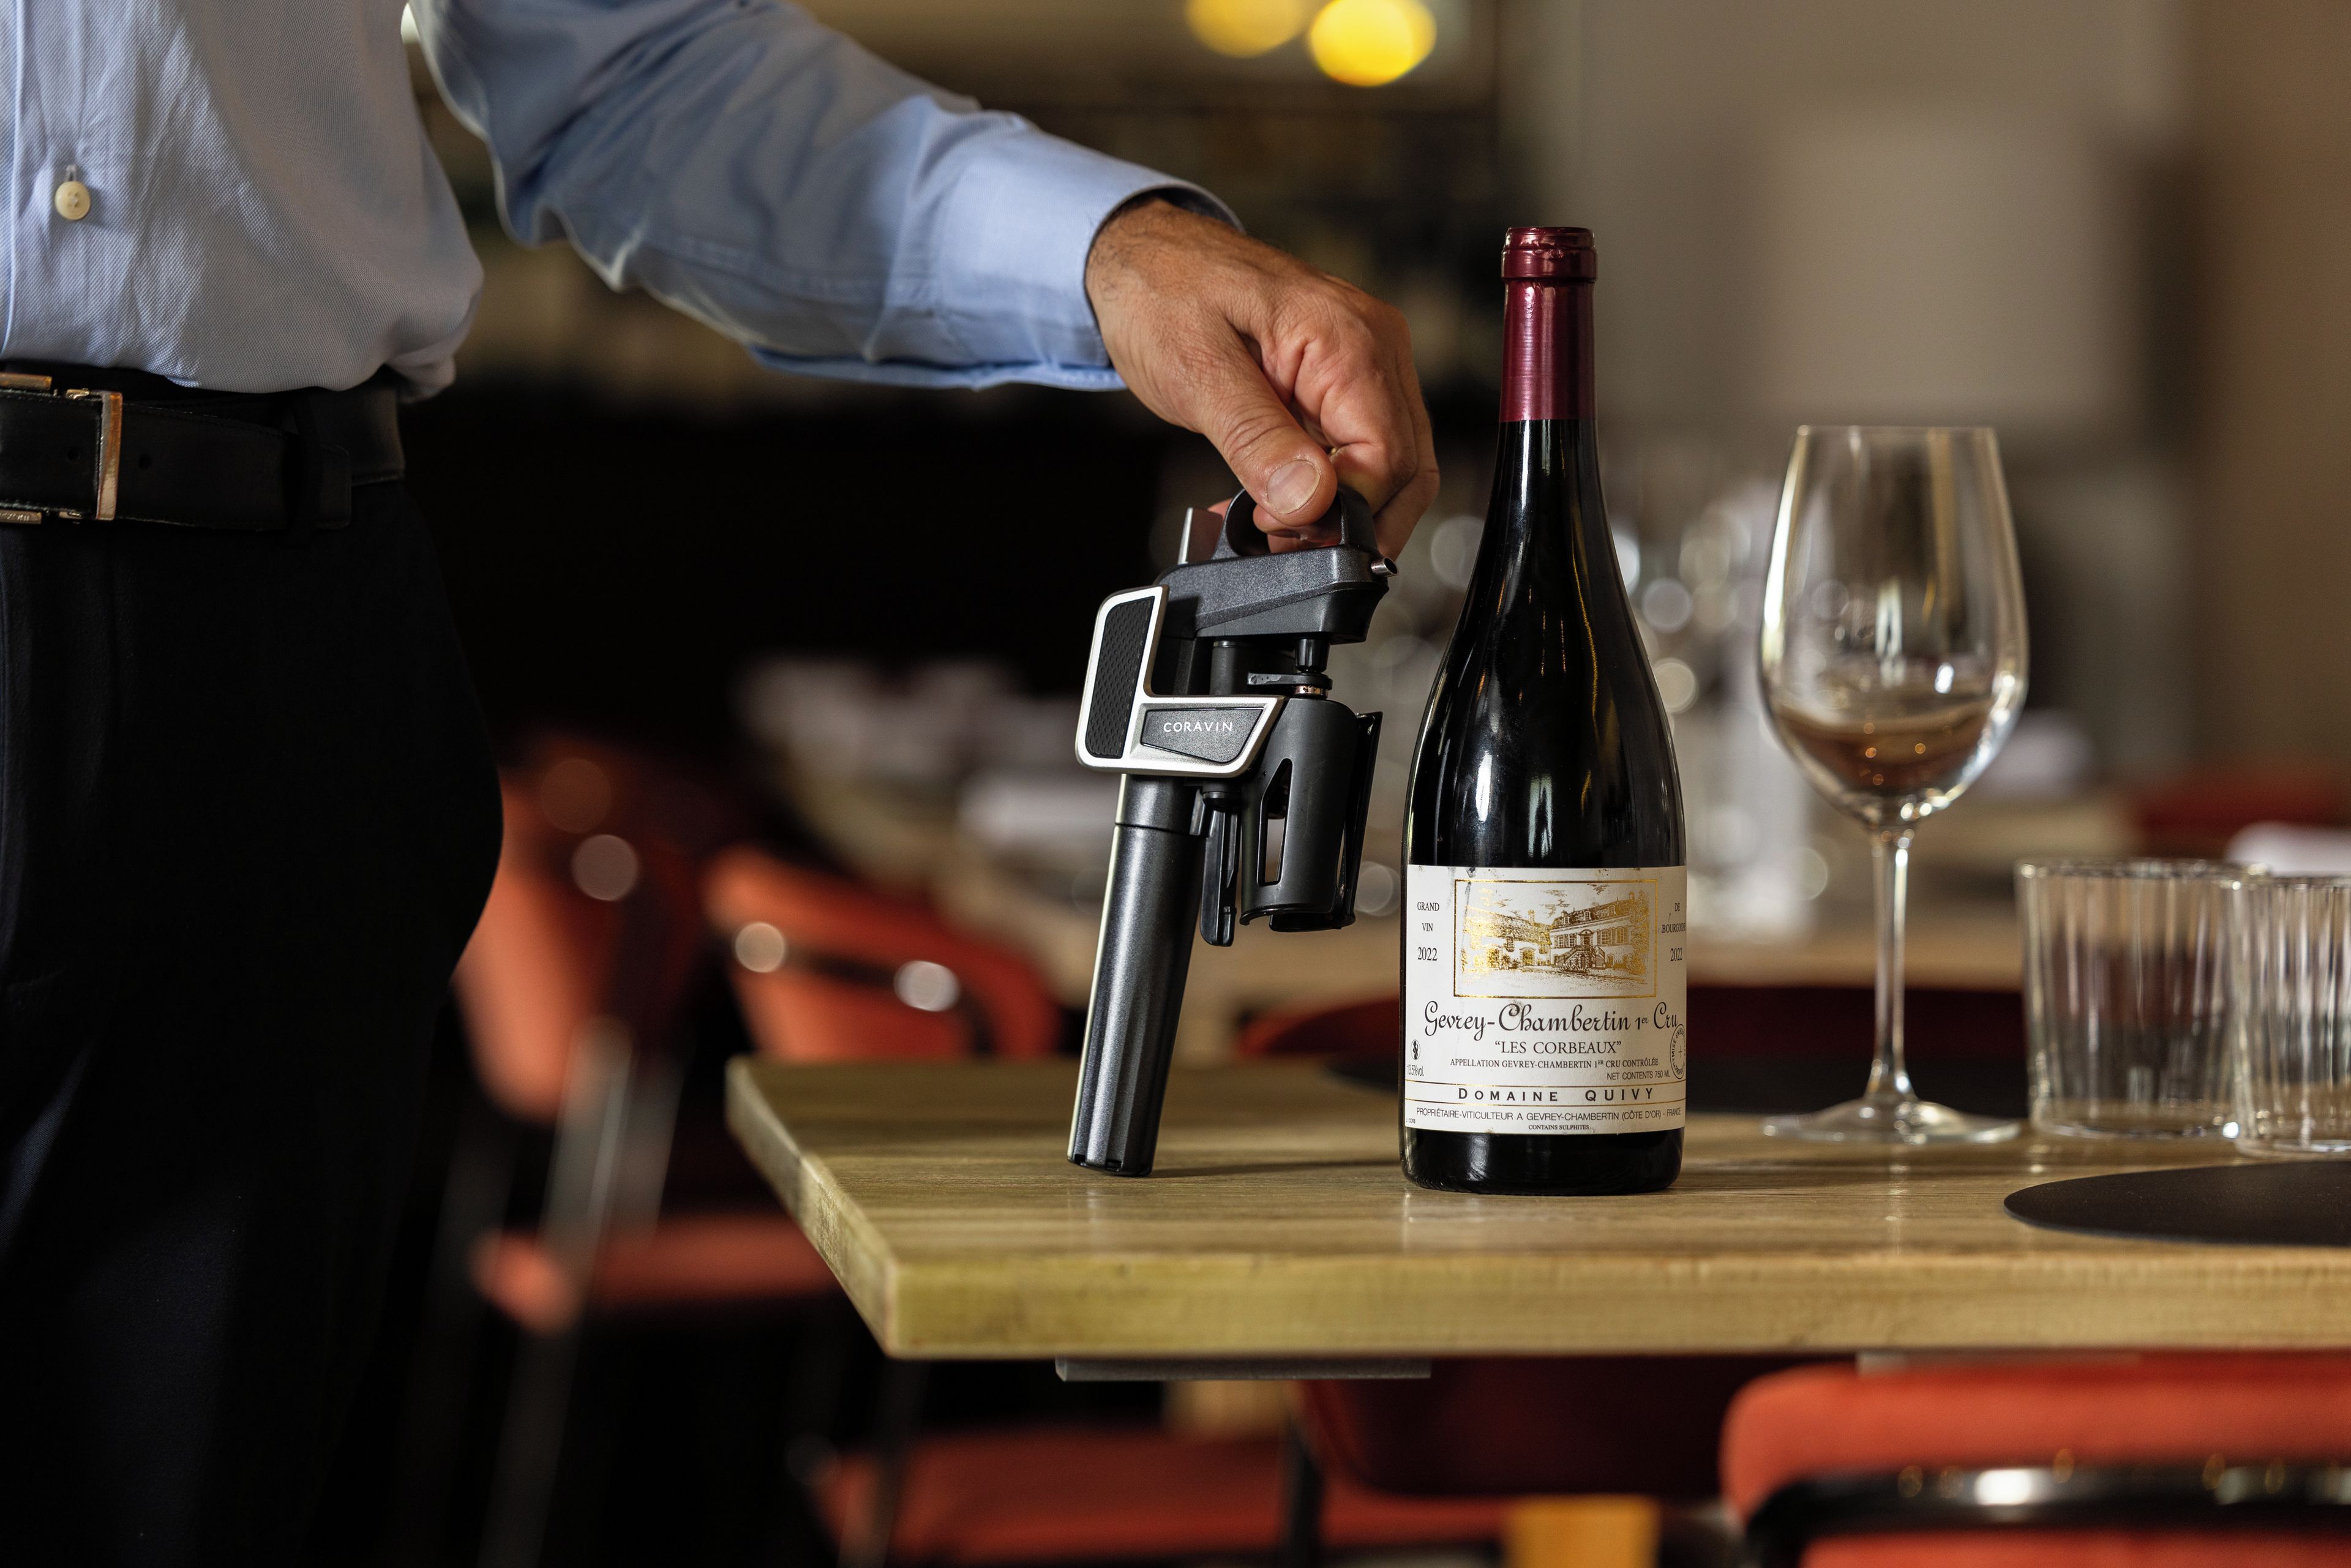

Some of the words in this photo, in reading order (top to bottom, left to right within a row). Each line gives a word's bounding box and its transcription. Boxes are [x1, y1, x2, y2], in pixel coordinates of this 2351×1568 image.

[1163, 721, 1232, 733] CORAVIN
[1417, 901, 1440, 912] GRAND
[1674, 902, 1681, 912] DE
[1422, 922, 1433, 932] VIN
[1417, 947, 1438, 961] 2022
[1670, 947, 1683, 962] 2022
[1425, 1000, 1631, 1041] Gevrey-Chambertin
[1653, 1002, 1678, 1029] Cru
[1450, 1059, 1500, 1067] APPELLATION
[1502, 1060, 1592, 1068] GEVREY-CHAMBERTIN
[1622, 1057, 1659, 1067] CONTRÔLÉE
[1607, 1072, 1620, 1081] NET
[1622, 1071, 1654, 1080] CONTENTS
[1458, 1087, 1558, 1101] DOMAINE
[1585, 1088, 1652, 1102] QUIVY
[1417, 1107, 1513, 1120] PROPRIÉTAIRE-VITICULTEUR
[1526, 1112, 1619, 1121] GEVREY-CHAMBERTIN
[1622, 1109, 1643, 1121] (CÔTE
[1666, 1107, 1681, 1116] FRANCE
